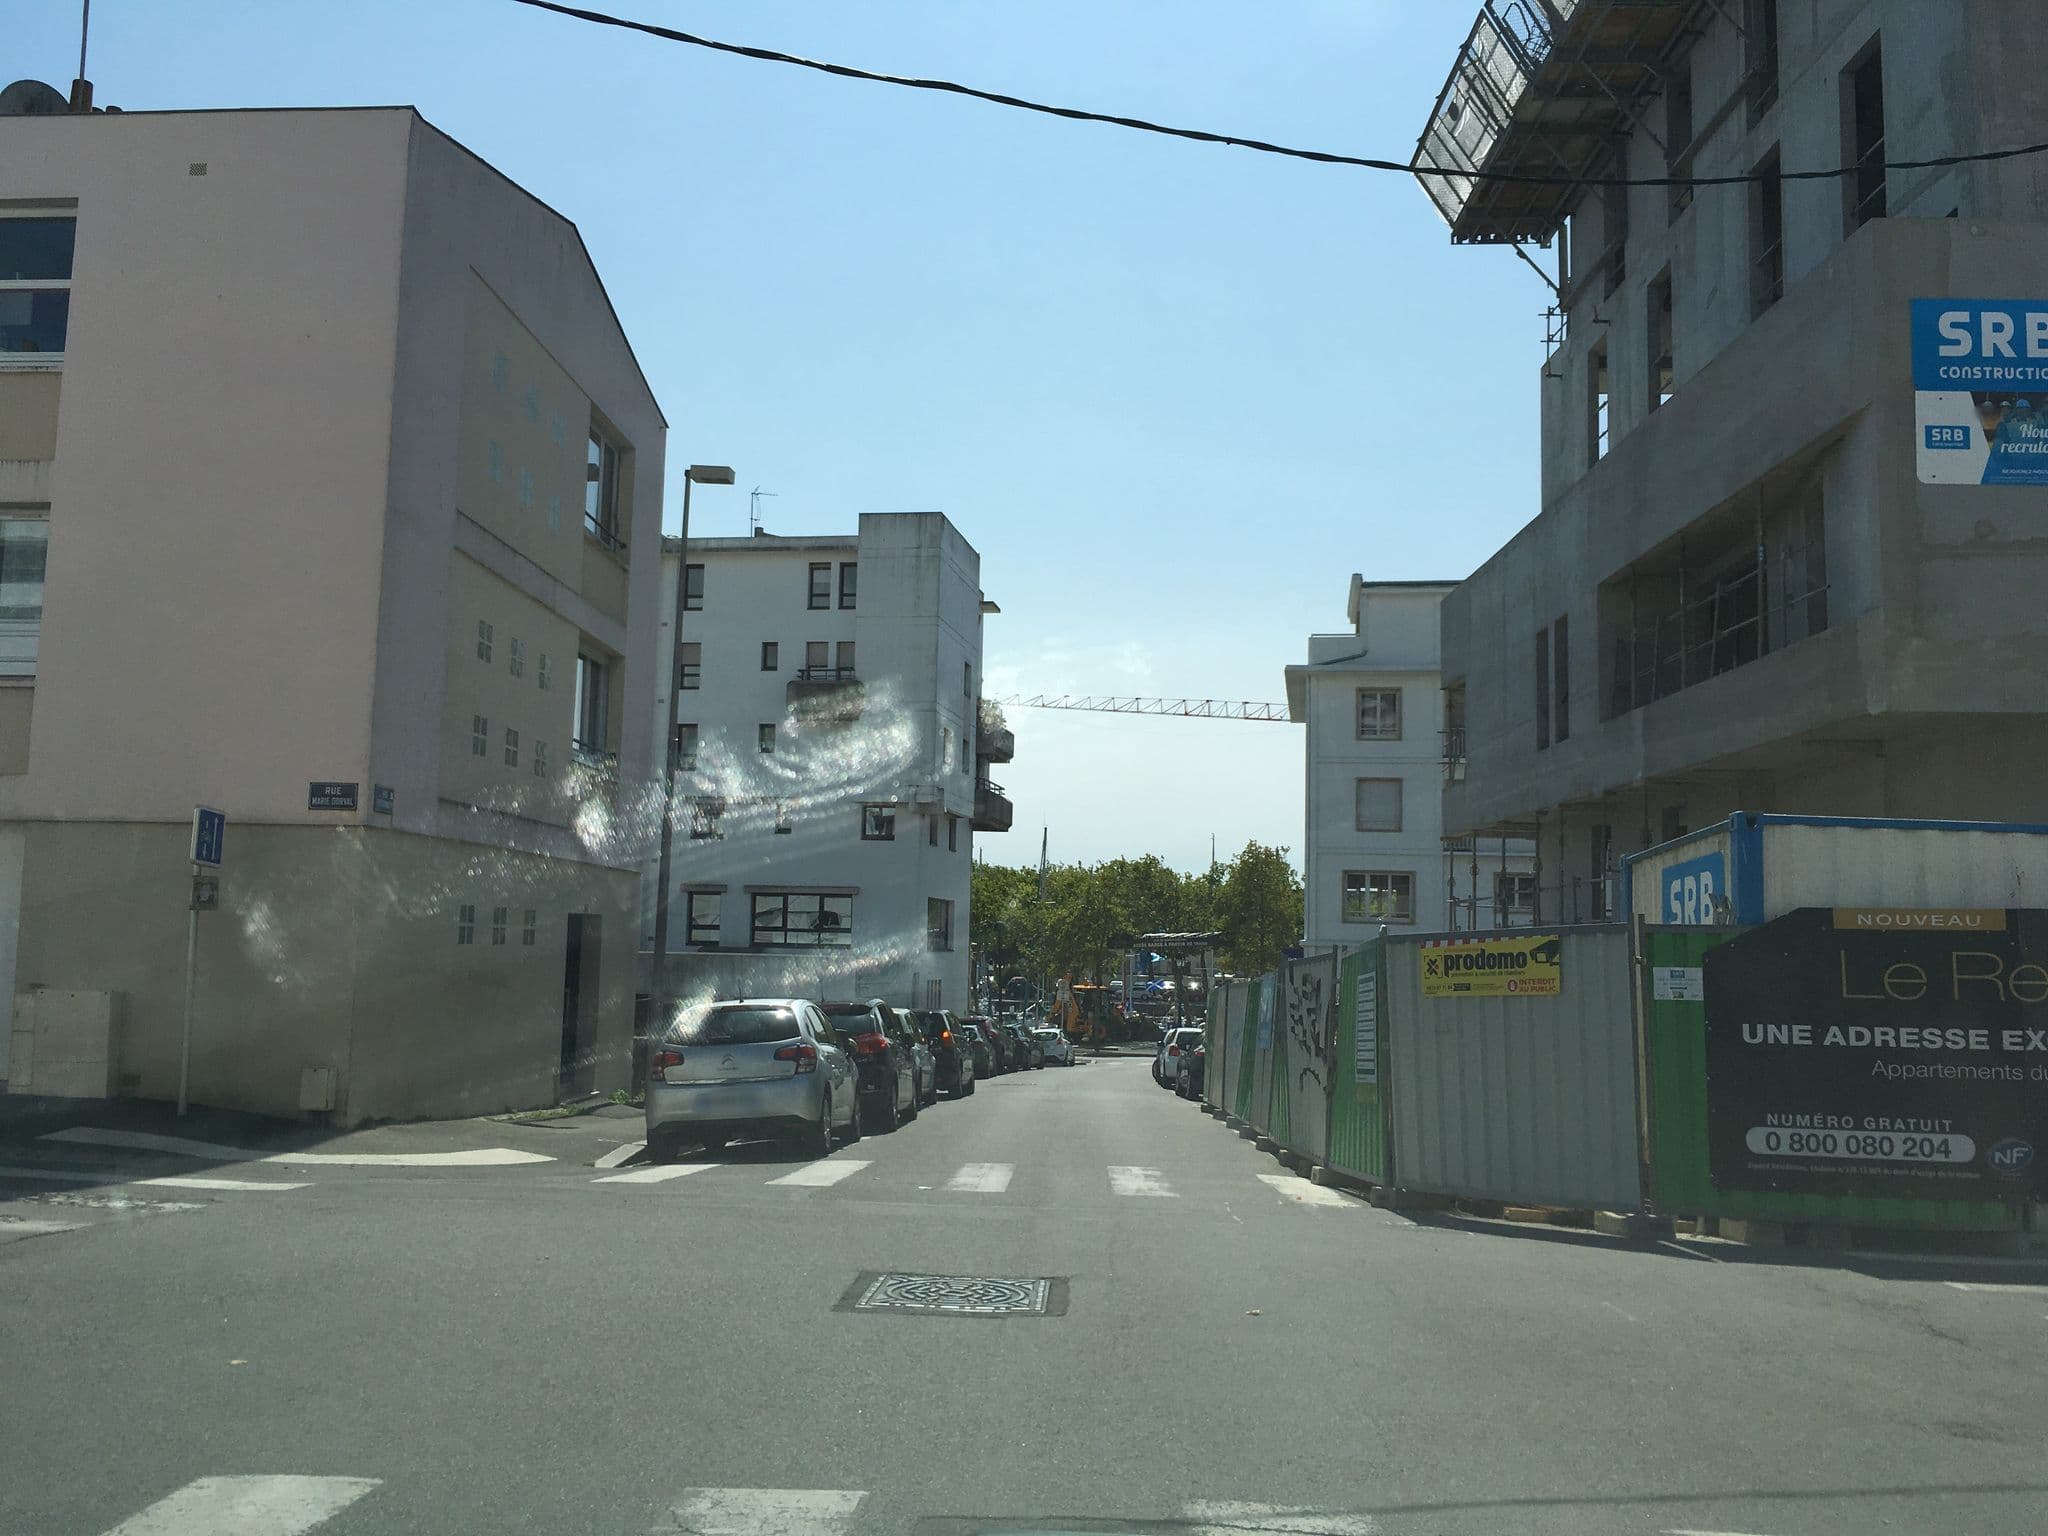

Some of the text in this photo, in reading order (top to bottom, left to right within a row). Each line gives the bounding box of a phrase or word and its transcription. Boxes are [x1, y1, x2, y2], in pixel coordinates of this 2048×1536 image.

[1938, 311, 2048, 358] SRB
[1931, 428, 1964, 442] SRB
[325, 786, 343, 795] RUE
[1670, 871, 1714, 925] SRB
[1857, 914, 1983, 927] NOUVEAU
[1444, 948, 1527, 977] prodomo
[1840, 950, 1927, 1001] Le
[1741, 1023, 2048, 1051] UNE ADRESSE EX
[1871, 1060, 2024, 1082] Appartements
[1767, 1111, 1953, 1133] NUMÉRO GRATUIT
[1765, 1131, 1953, 1160] 0 800 080 204
[1993, 1148, 2030, 1167] NF
